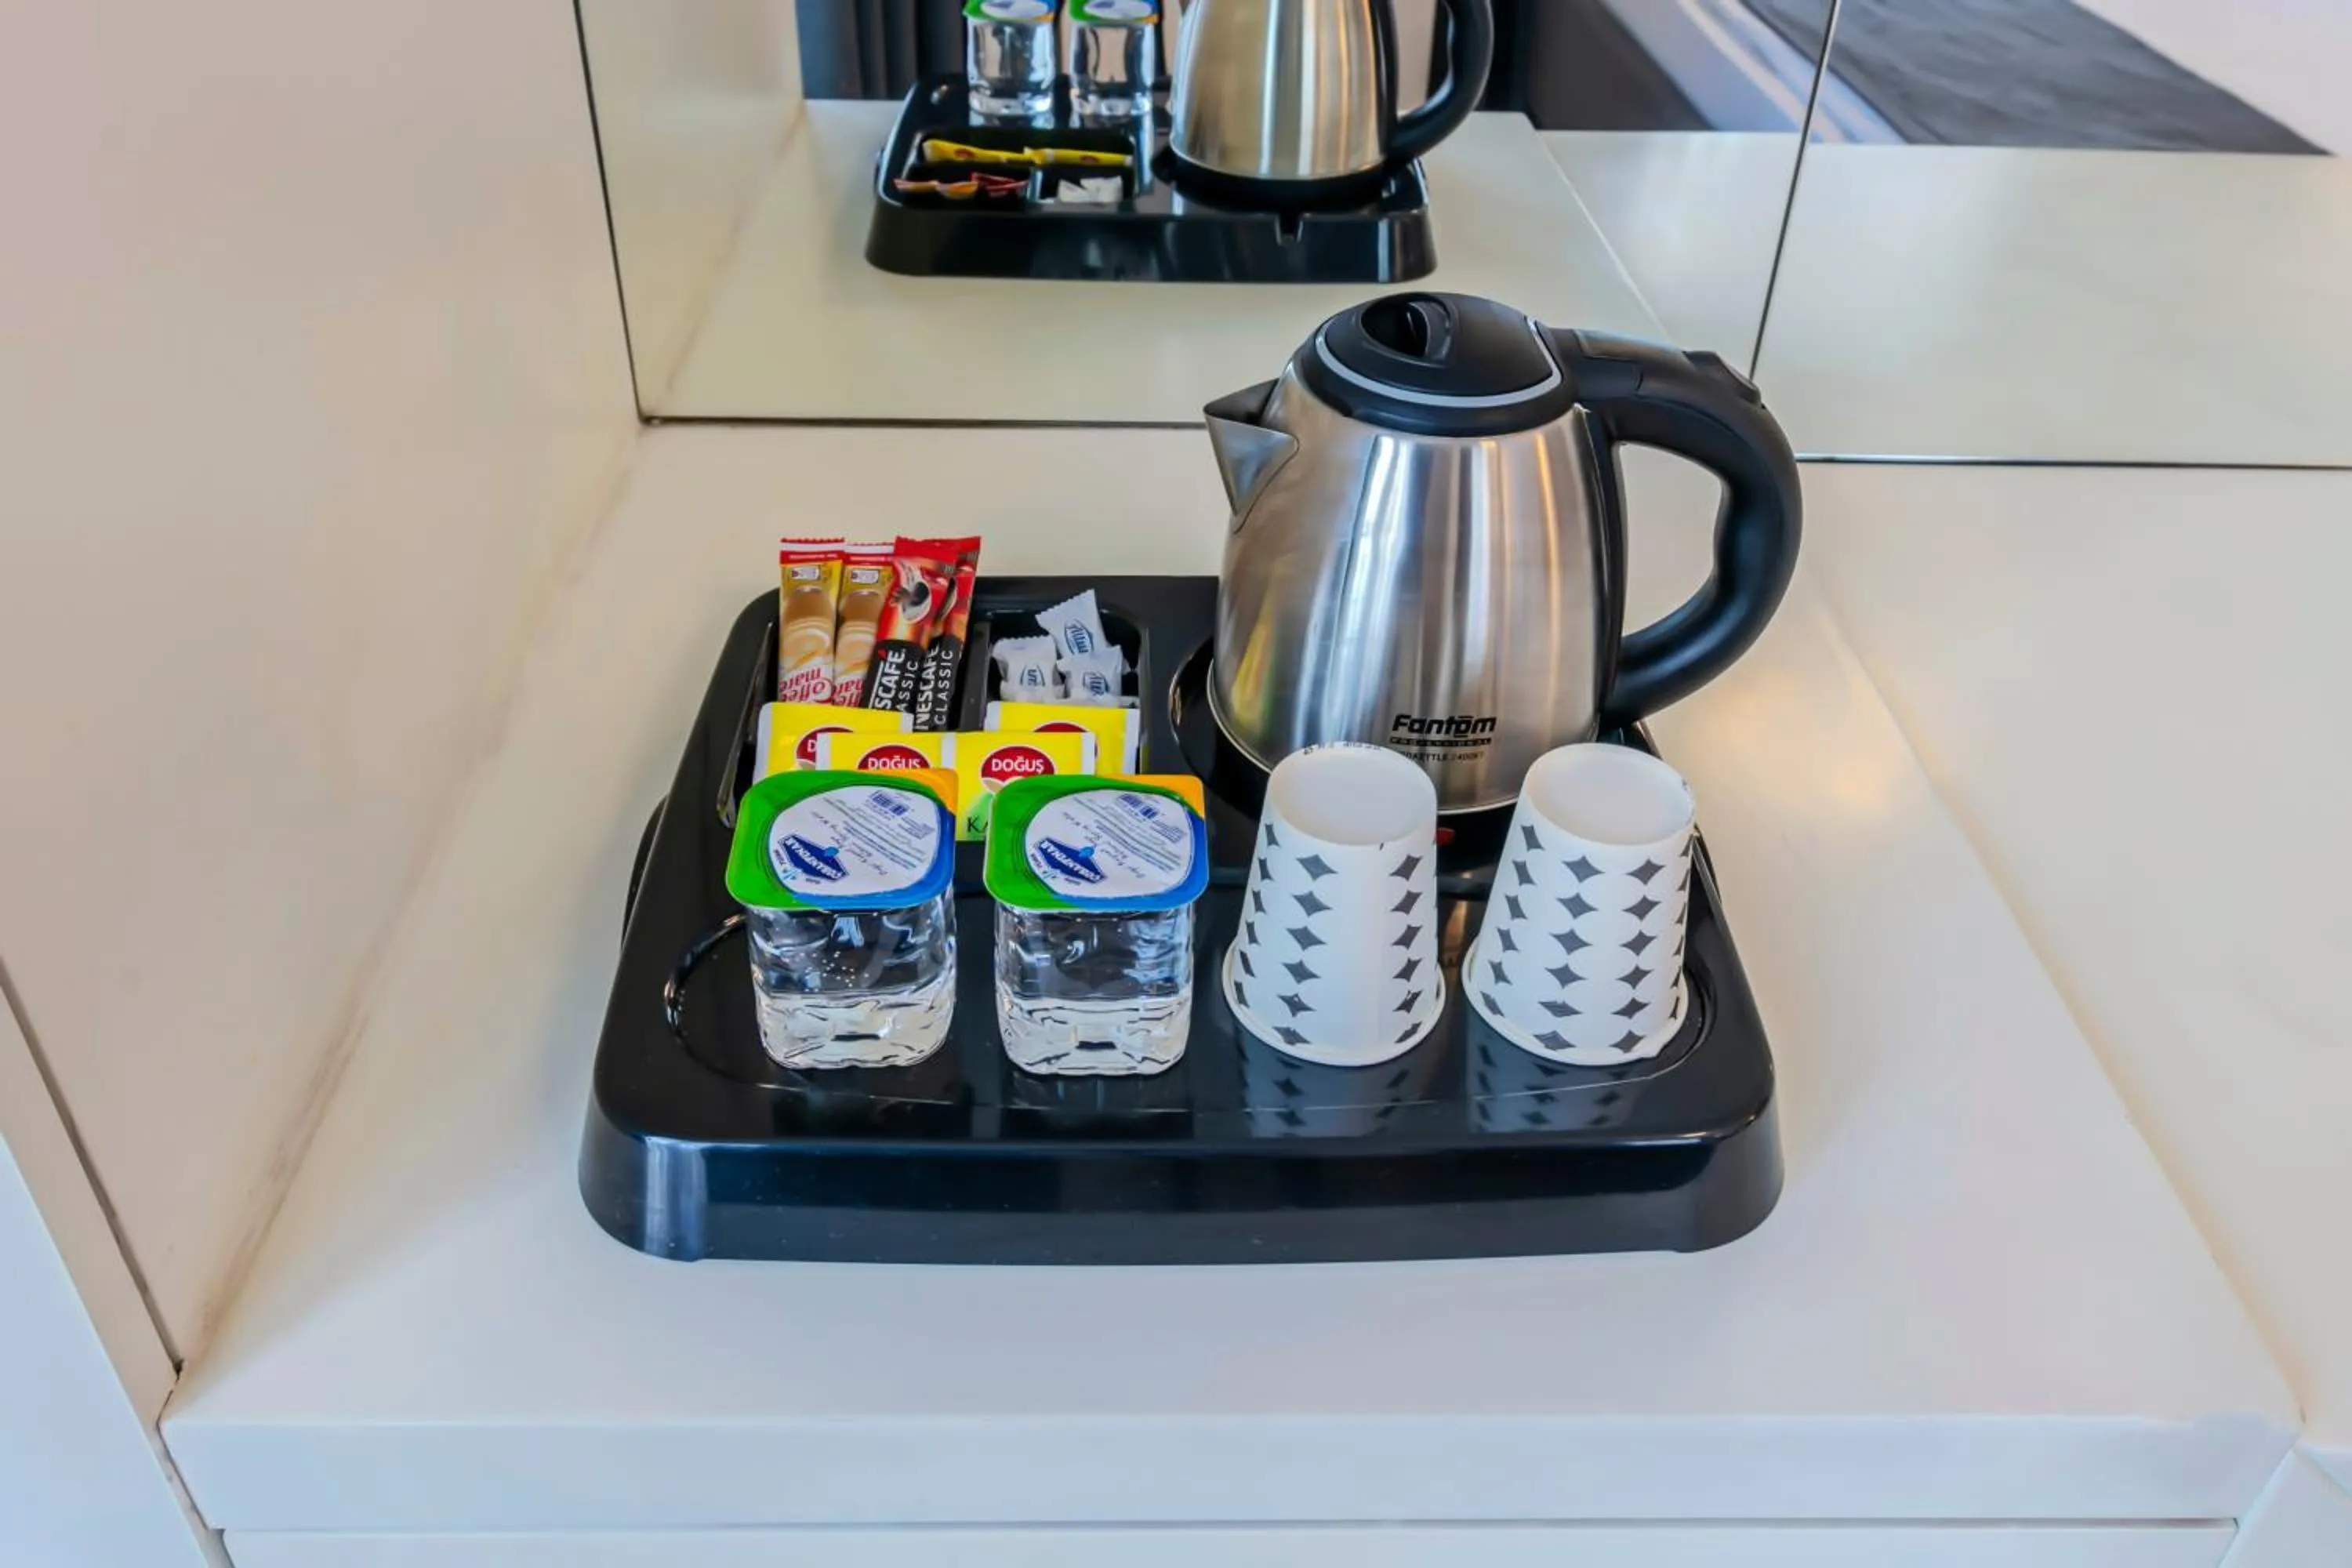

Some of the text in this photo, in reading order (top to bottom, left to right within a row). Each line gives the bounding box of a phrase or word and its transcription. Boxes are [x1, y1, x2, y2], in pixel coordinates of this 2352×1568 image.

[896, 660, 919, 713] ASSIC
[934, 649, 954, 725] CLASSIC
[991, 755, 1044, 774] DOĞUŞ
